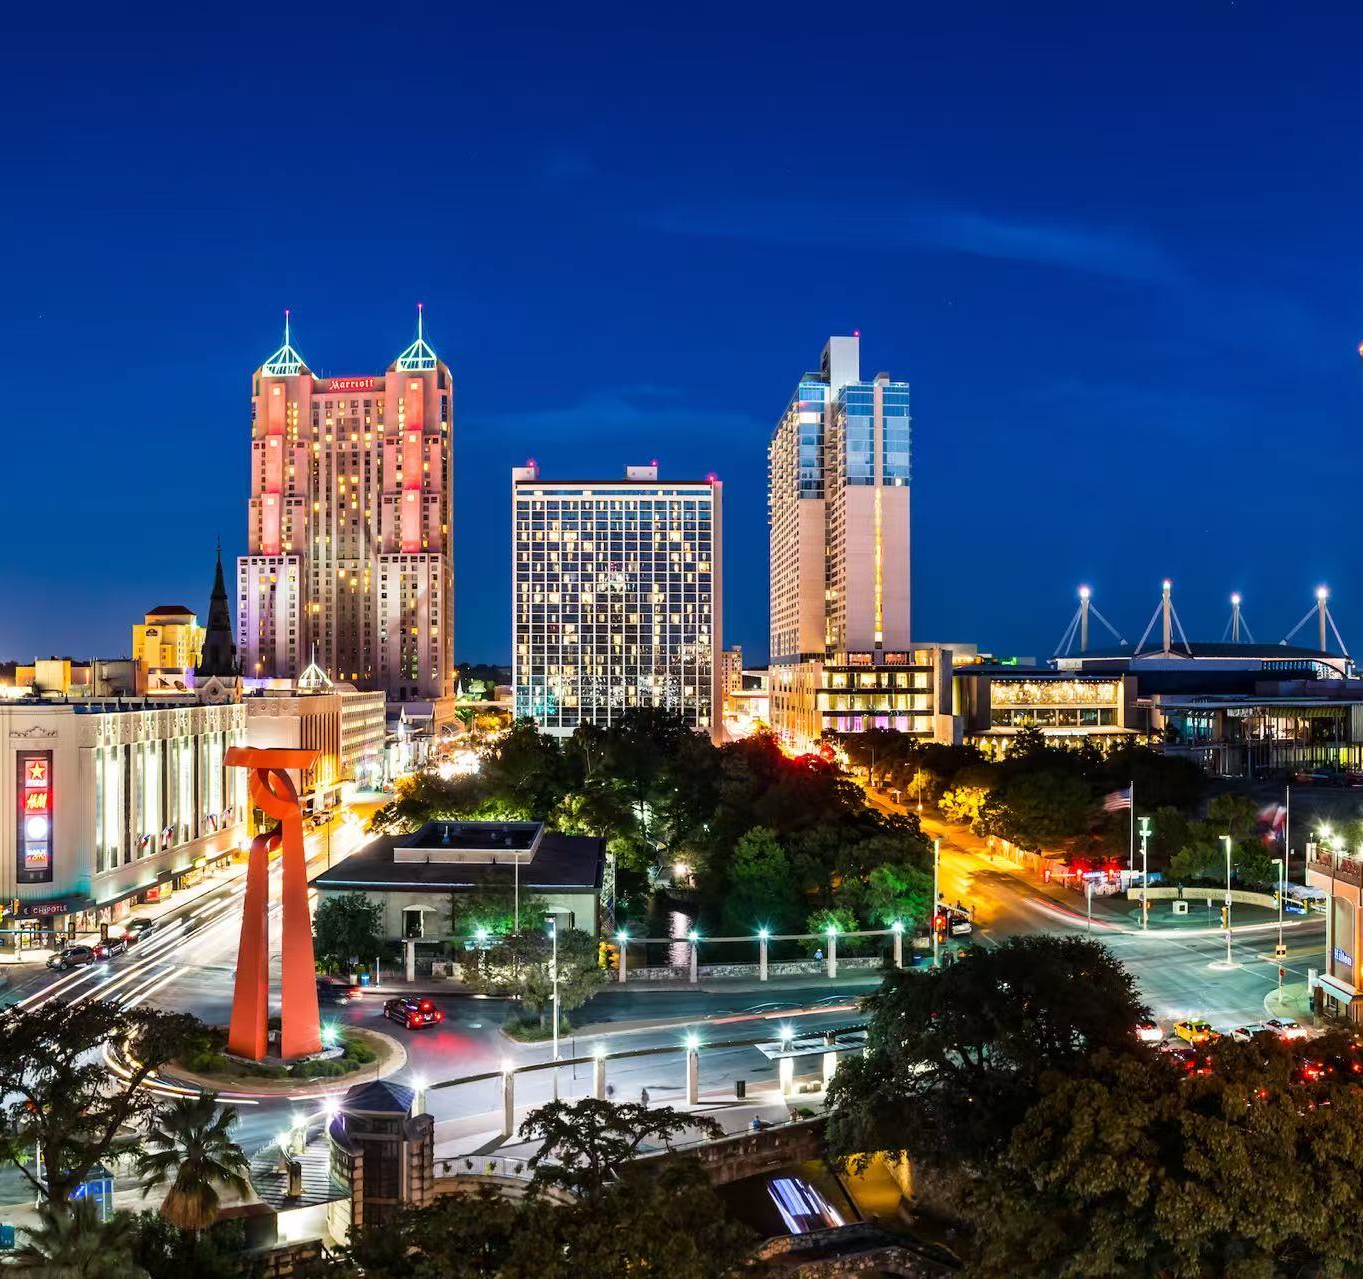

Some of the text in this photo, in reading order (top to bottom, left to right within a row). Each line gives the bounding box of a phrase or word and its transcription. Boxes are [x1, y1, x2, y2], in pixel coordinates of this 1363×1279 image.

[329, 379, 374, 390] Marriott
[32, 904, 68, 914] CHIPOTLE
[1334, 948, 1352, 967] Hilton
